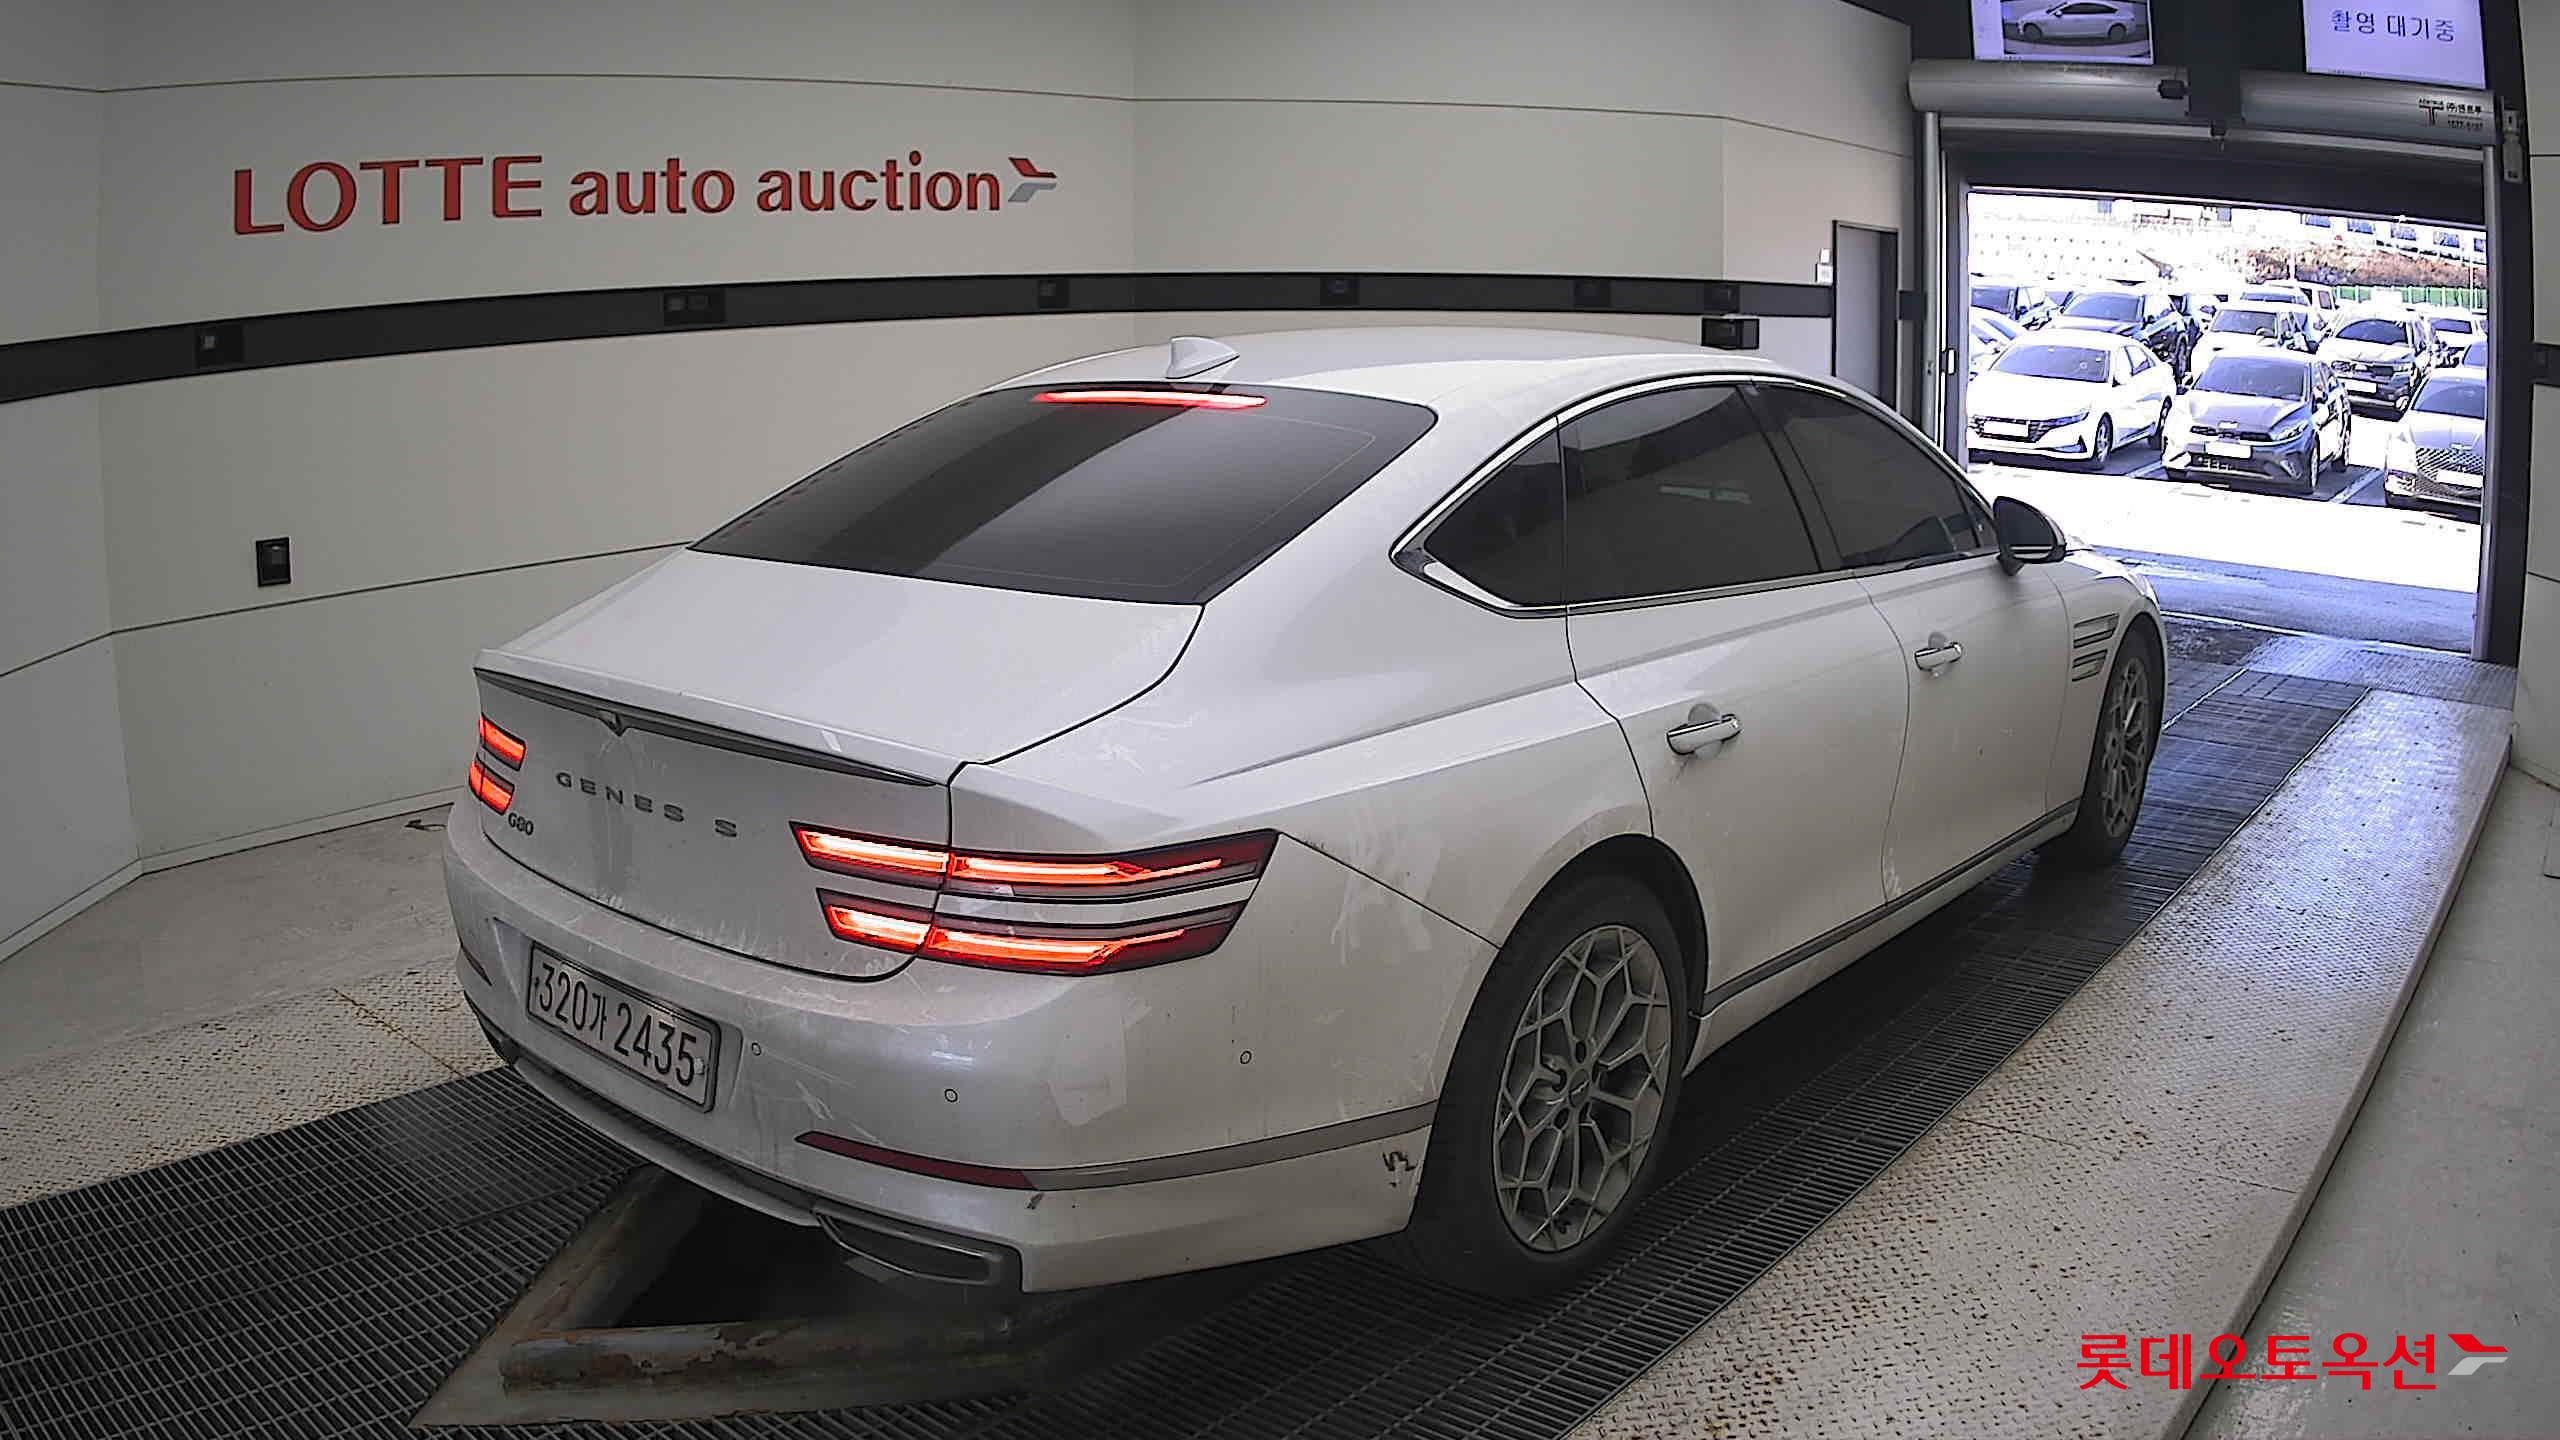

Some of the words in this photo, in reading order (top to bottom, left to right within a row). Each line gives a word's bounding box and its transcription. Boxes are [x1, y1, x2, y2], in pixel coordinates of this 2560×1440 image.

[2331, 9, 2375, 34] 촬영
[2386, 15, 2455, 42] 대기중
[234, 155, 542, 235] LOTTE
[569, 157, 735, 216] auto
[756, 150, 1001, 212] auction
[508, 812, 534, 836] G80
[556, 772, 737, 837] GENESS
[539, 963, 607, 1041] 320가
[614, 1002, 697, 1087] 2435
